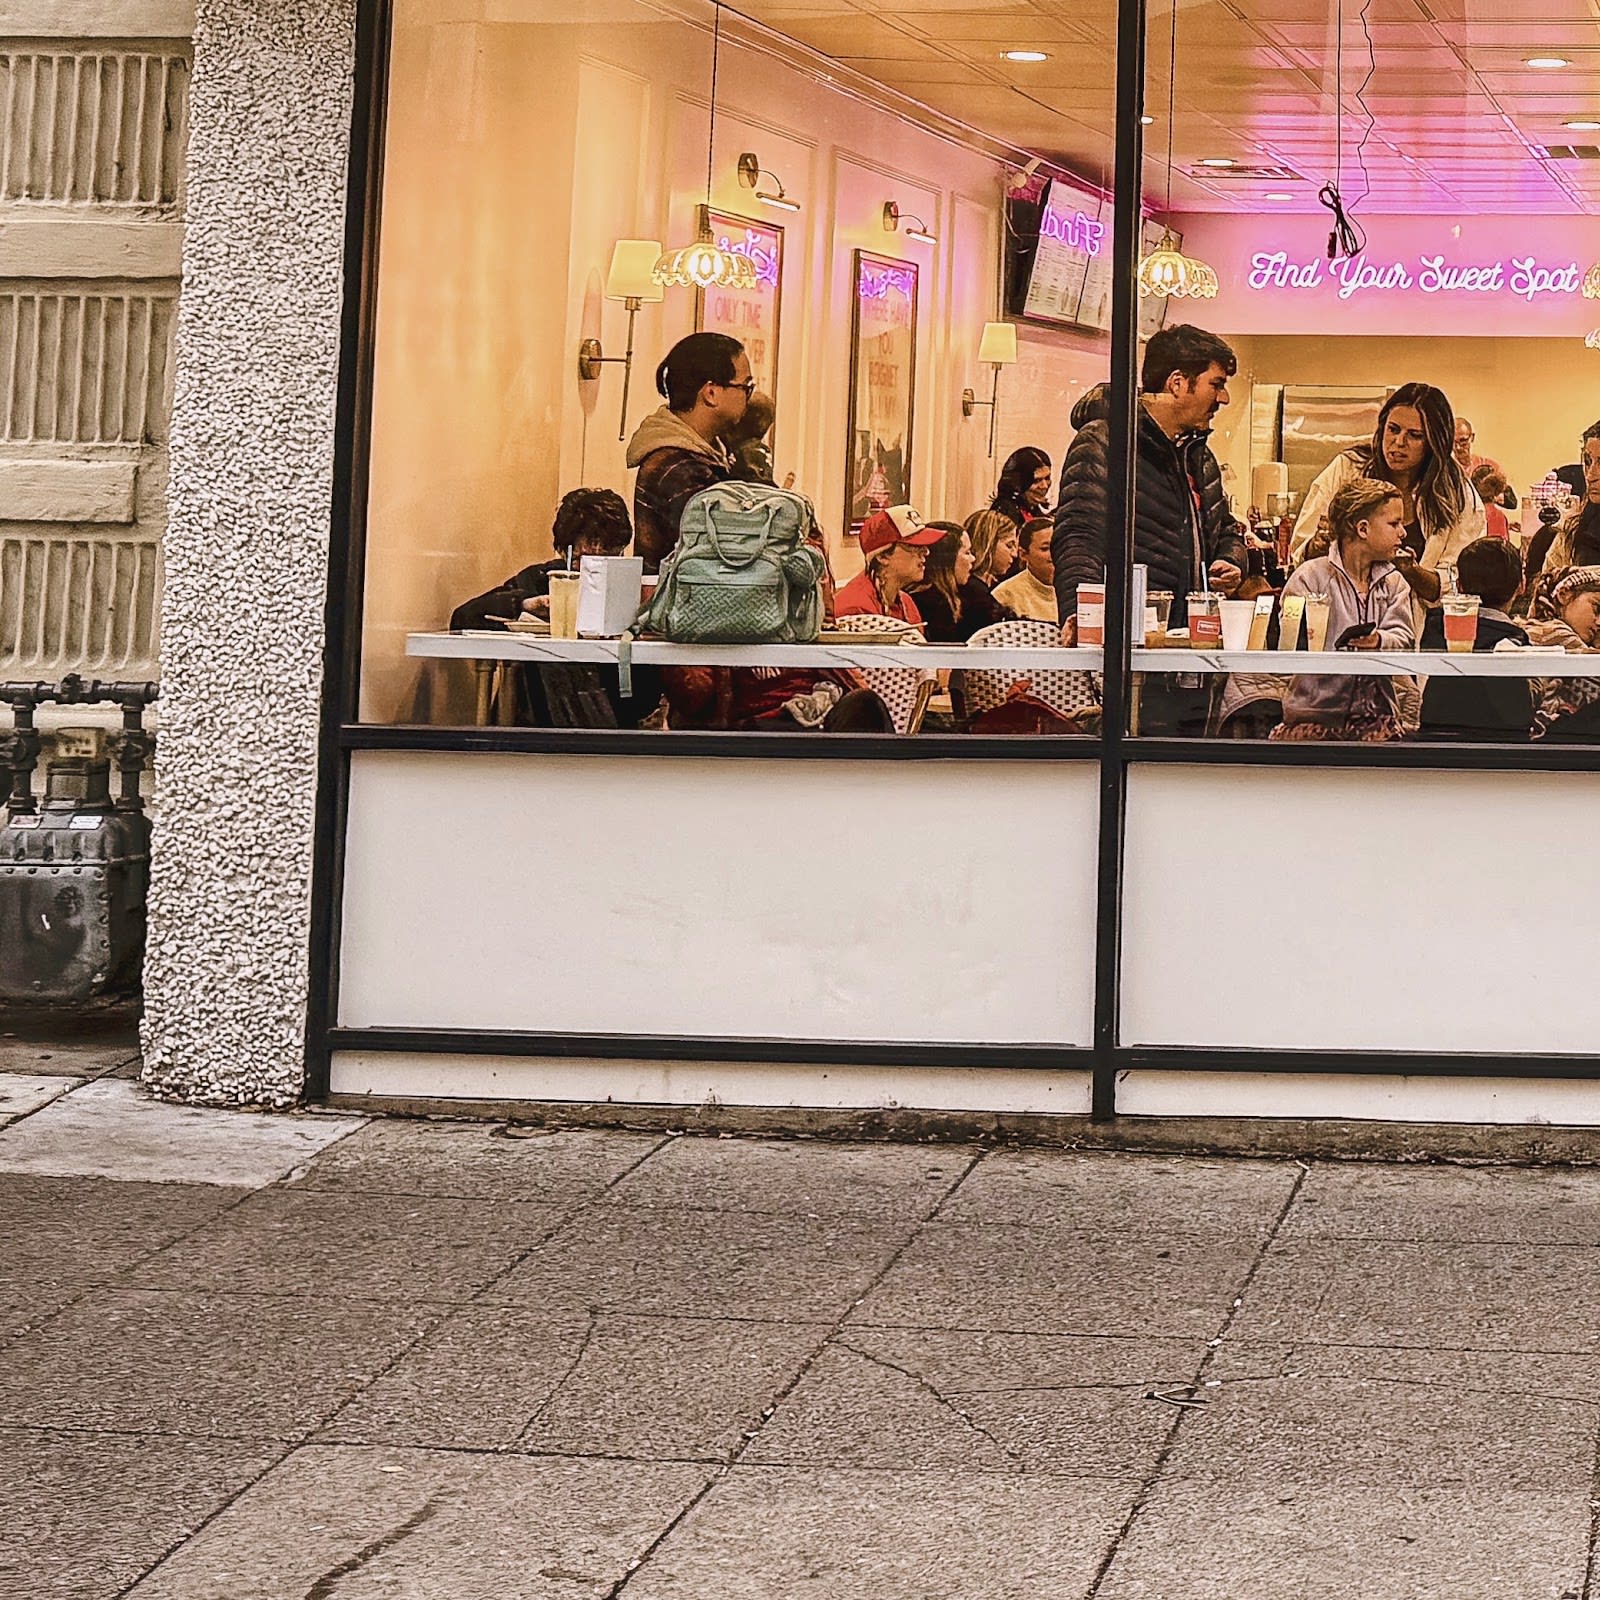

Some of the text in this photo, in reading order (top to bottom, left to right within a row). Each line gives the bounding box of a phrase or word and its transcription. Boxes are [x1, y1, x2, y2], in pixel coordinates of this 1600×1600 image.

[1248, 250, 1581, 302] Find Your Sweet Spot
